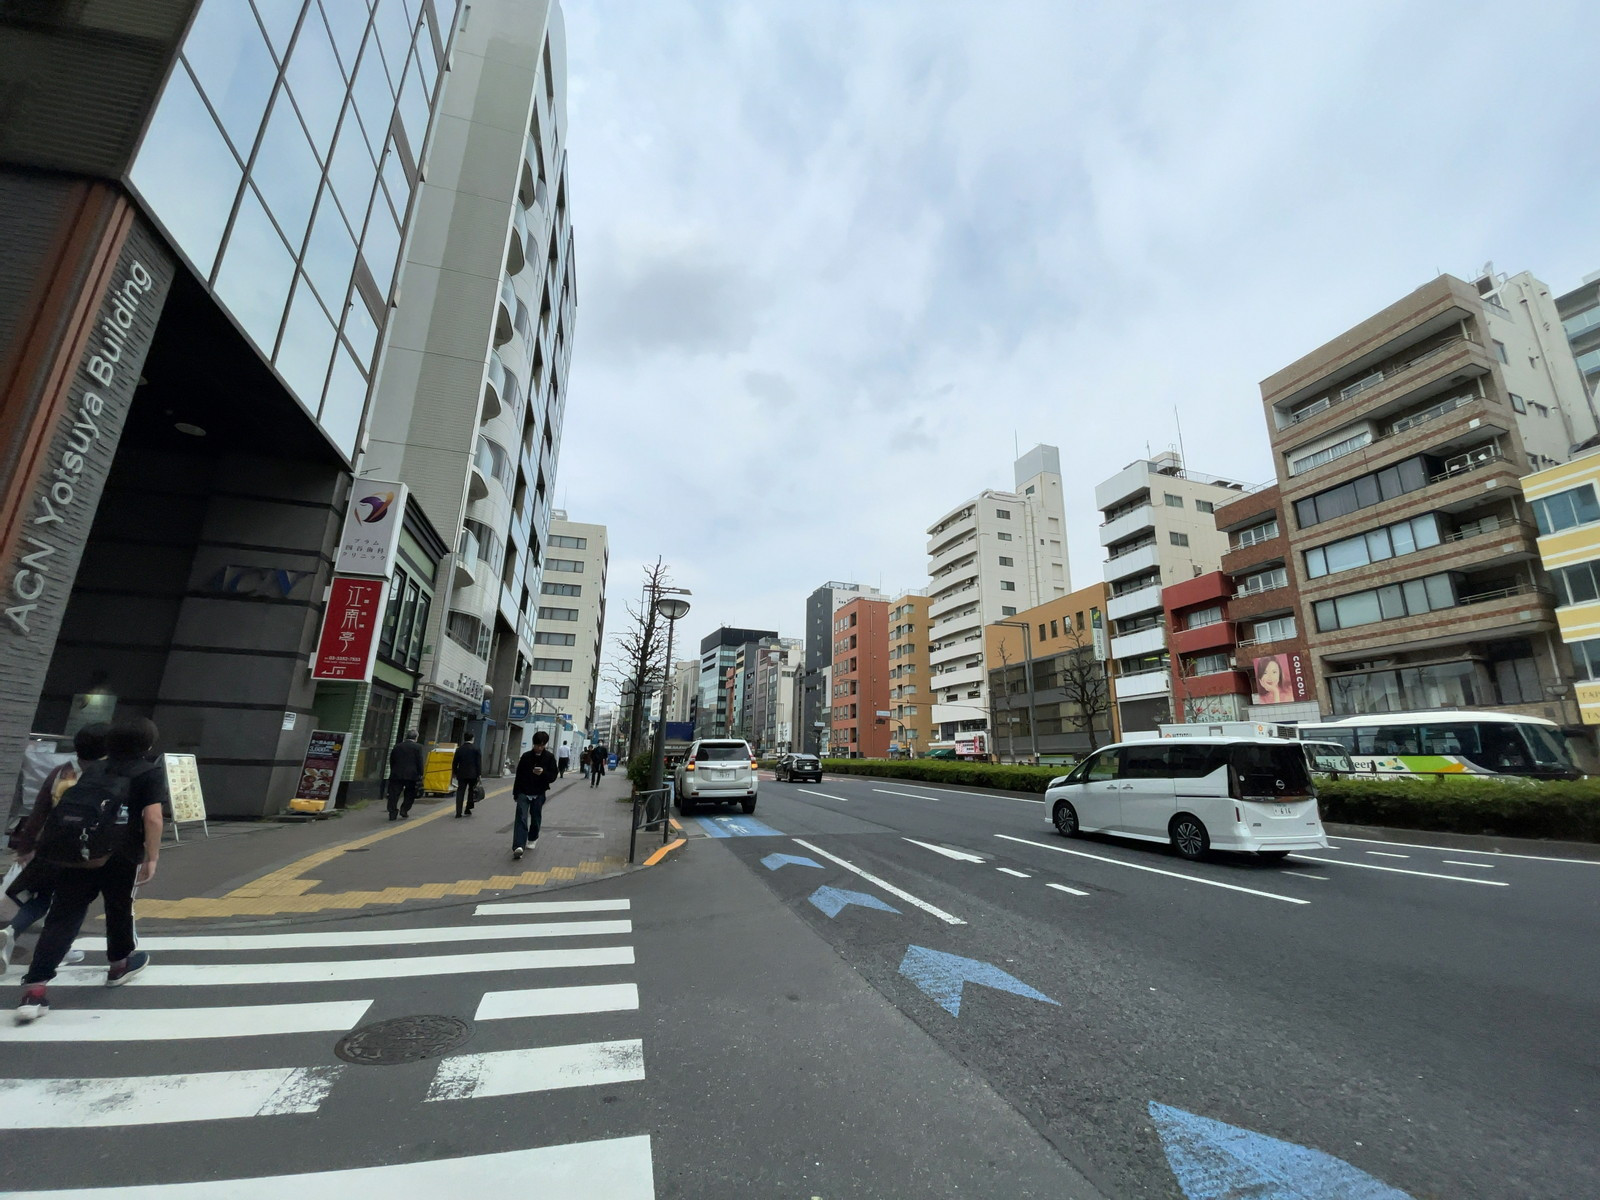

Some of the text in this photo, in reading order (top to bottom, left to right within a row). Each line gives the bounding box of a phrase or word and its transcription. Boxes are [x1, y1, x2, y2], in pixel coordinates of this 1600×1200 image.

[4, 260, 152, 632] ACN Yotsuya Building
[339, 586, 365, 653] 江南亭
